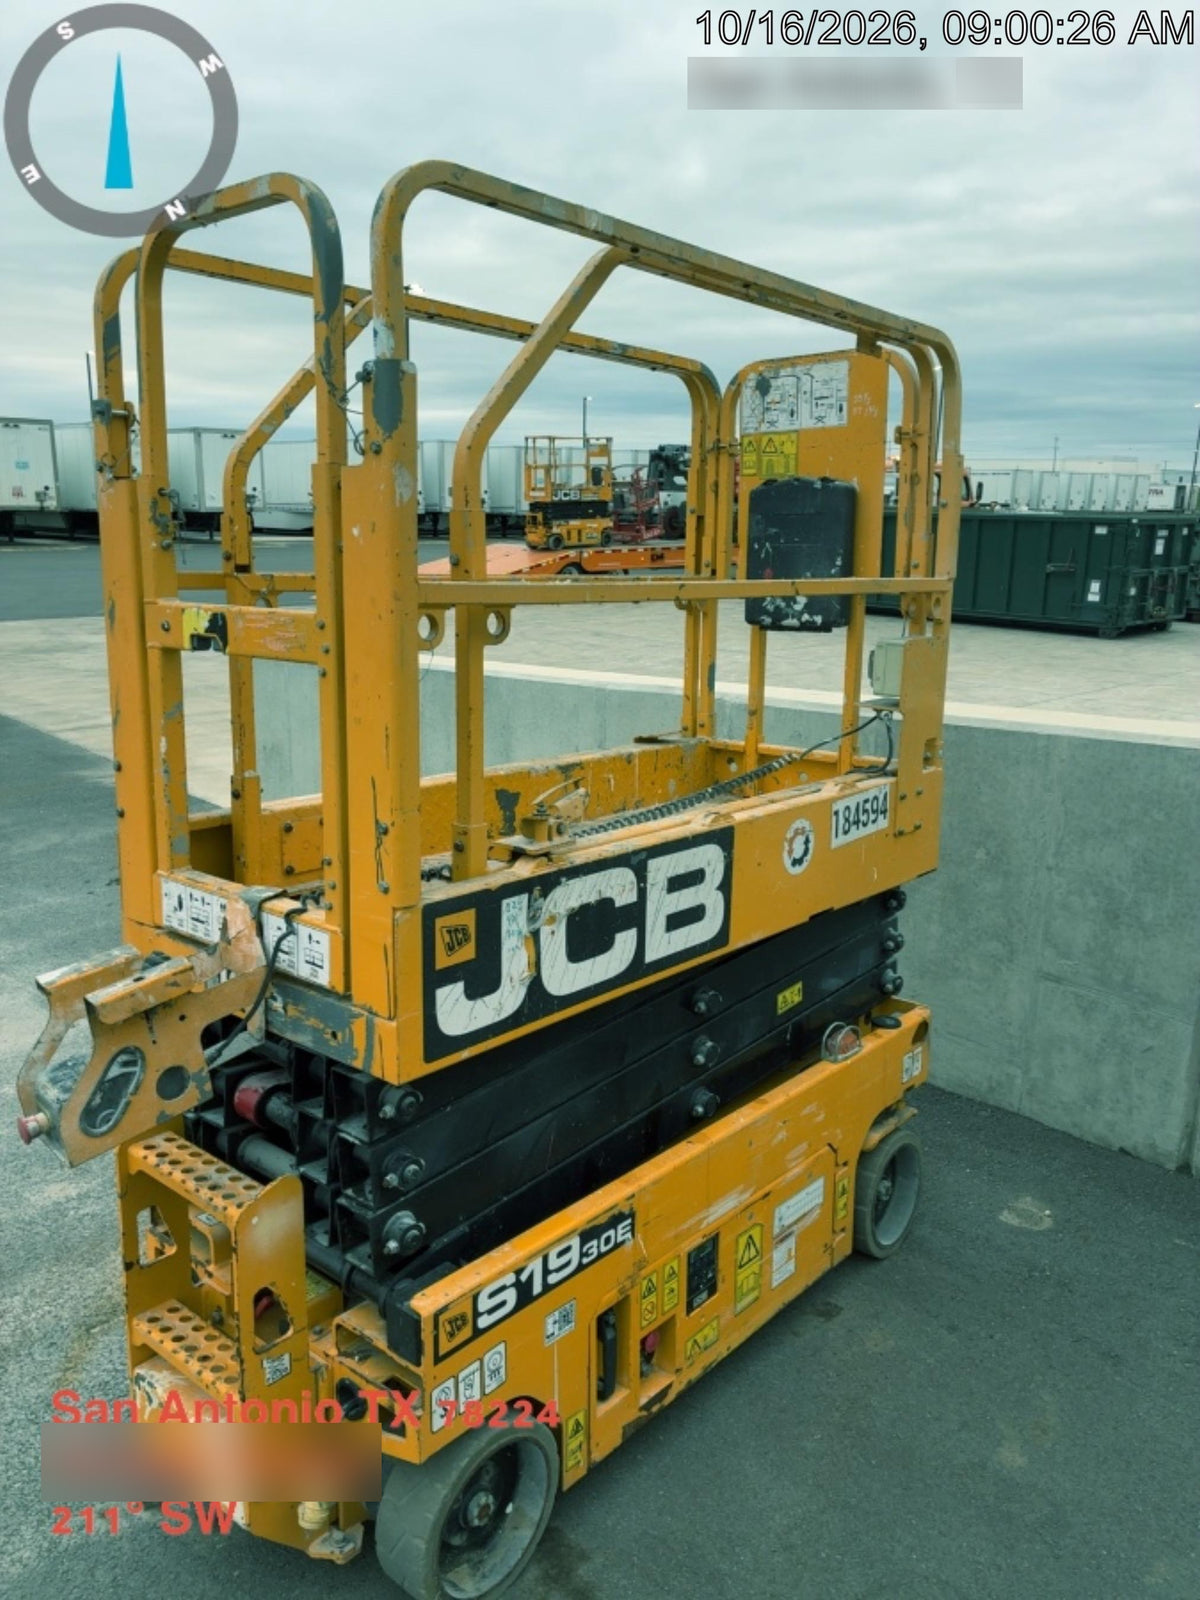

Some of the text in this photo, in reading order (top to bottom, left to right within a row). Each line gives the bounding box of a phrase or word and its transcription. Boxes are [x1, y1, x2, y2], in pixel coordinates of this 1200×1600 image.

[552, 489, 580, 500] JCB
[833, 791, 888, 839] 184594
[435, 843, 725, 1036] JCB
[444, 924, 471, 953] JCB
[445, 1312, 469, 1339] JCB
